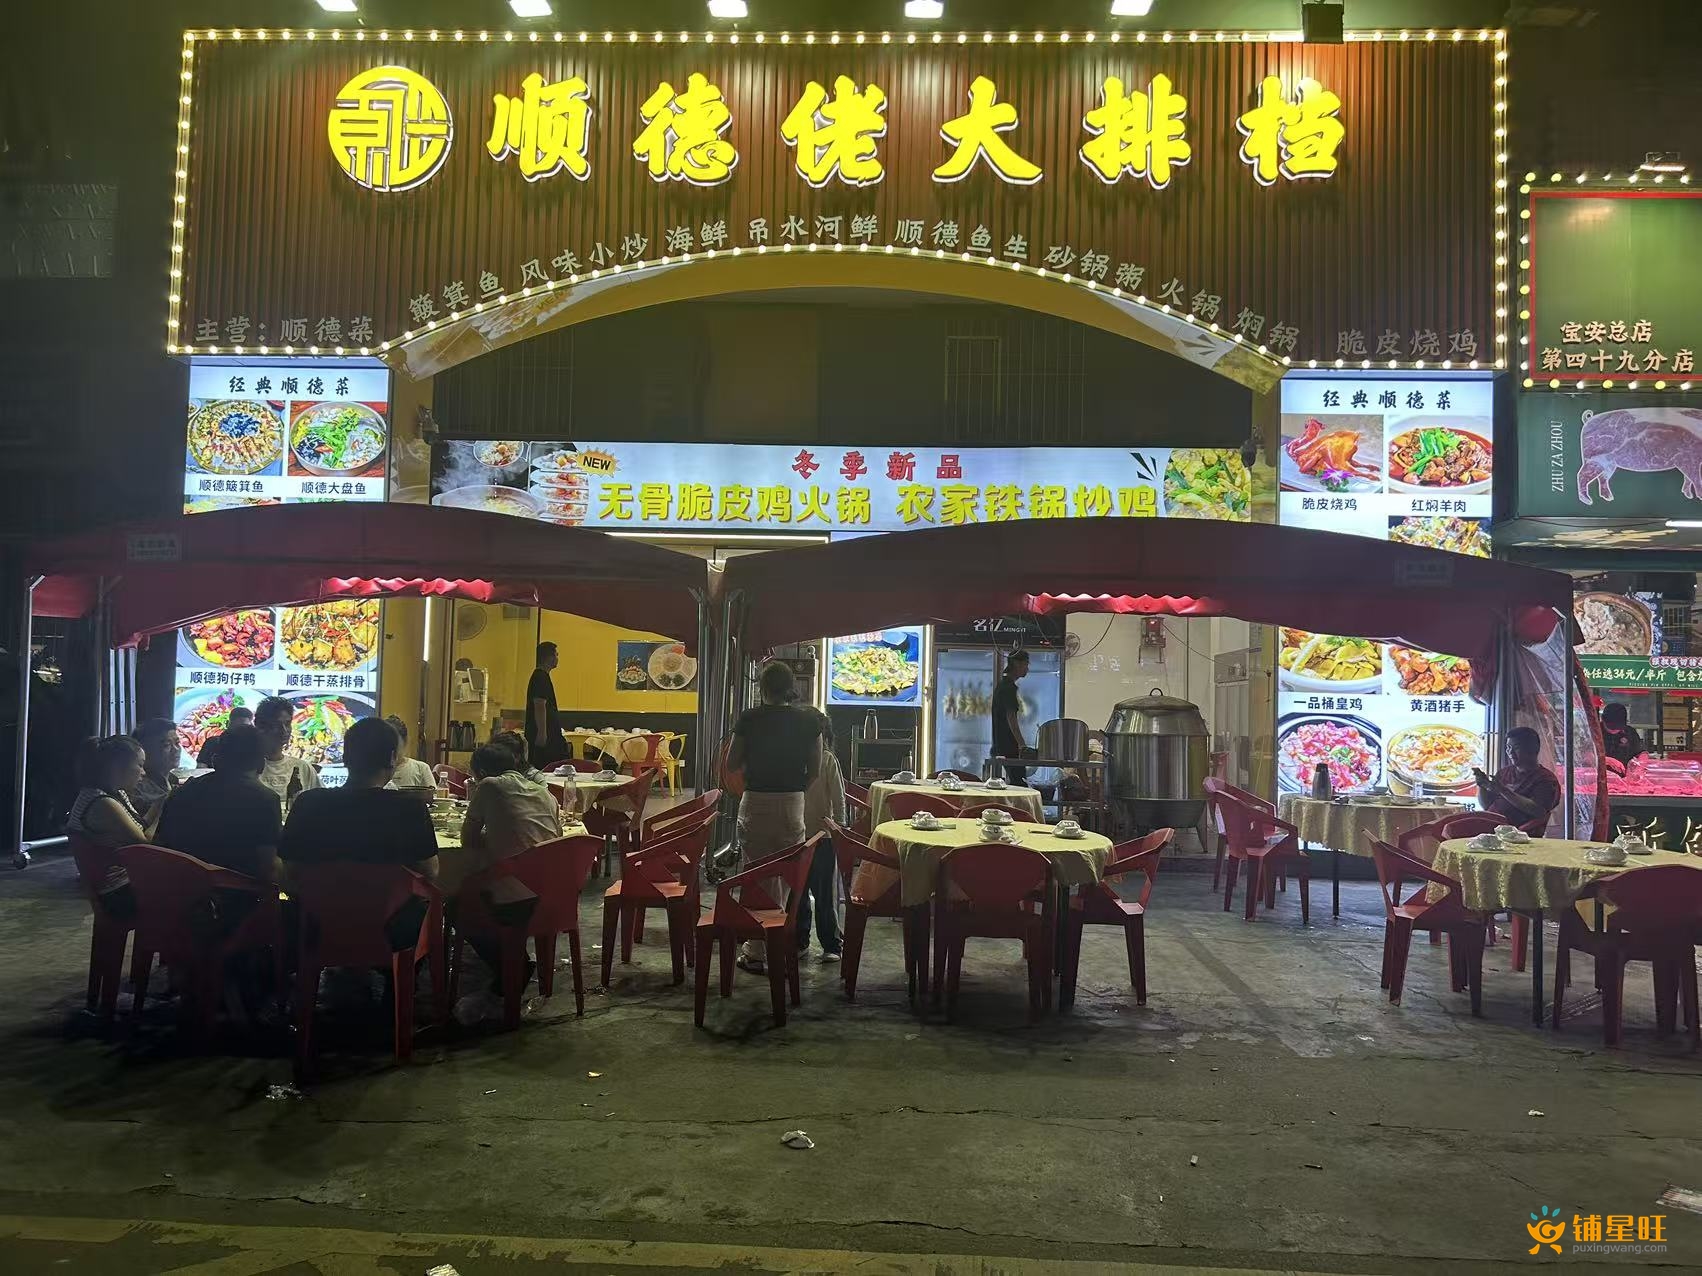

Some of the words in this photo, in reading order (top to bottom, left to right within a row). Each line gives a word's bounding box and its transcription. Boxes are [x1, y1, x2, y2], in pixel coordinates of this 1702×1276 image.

[487, 72, 1346, 189] 顺德佬大排档
[408, 269, 505, 323] 簸箕鱼
[520, 232, 649, 286] 风味小炒
[665, 222, 728, 253] 海鲜
[748, 214, 879, 245] 吊水河鲜
[895, 218, 1029, 260] 顺德鱼生
[1043, 245, 1146, 292] 砂锅粥
[1158, 276, 1224, 321] 火锅
[1233, 306, 1301, 353] 焖锅
[1336, 327, 1479, 357] 脆皮烧鸡
[1560, 319, 1653, 343] 宝安总店
[1542, 347, 1695, 373] 第四十九分店
[228, 375, 351, 397] 经典顺德菜
[1322, 388, 1453, 411] 经典顺德菜
[1550, 420, 1563, 451] ZHOU
[583, 456, 611, 471] NEW
[791, 448, 963, 482] 冬季新品
[1551, 453, 1564, 467] ZA
[199, 479, 264, 493] 顺德簸箕鱼
[301, 481, 367, 495] 顺德大盘鱼
[1551, 469, 1564, 492] ZHU
[599, 482, 871, 524] 无骨脆皮鸡火锅
[896, 483, 1157, 525] 农家铁锅炒鸡
[1301, 498, 1358, 512] 脆皮烧鸡
[1411, 499, 1467, 514] 红焖羊肉
[190, 671, 256, 685] 顺德狗仔鸭
[286, 673, 365, 688] 顺德干蒸排骨
[1293, 696, 1363, 711] 一品桶皇鸡
[1410, 698, 1466, 713] 黄酒猪手
